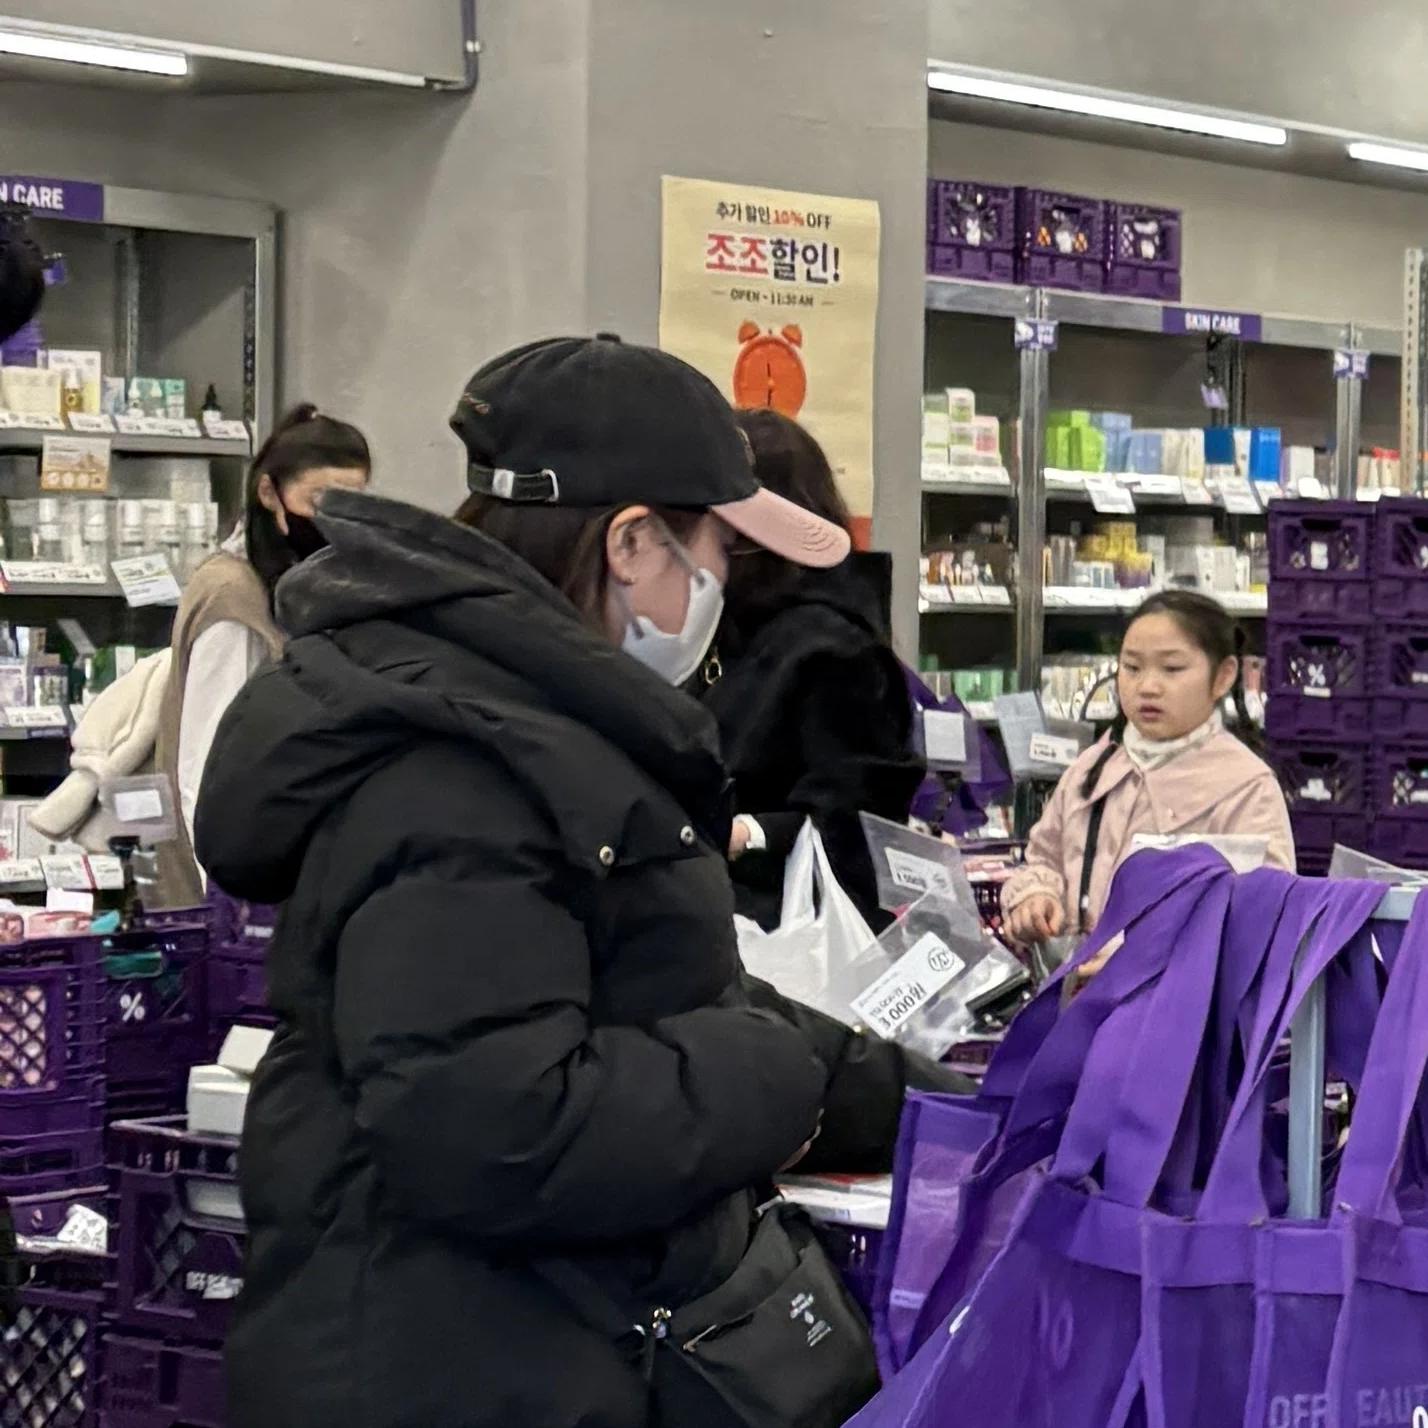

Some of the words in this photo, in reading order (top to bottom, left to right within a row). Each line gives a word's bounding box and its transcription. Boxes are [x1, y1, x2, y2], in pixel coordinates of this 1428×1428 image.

[13, 183, 65, 211] CARE
[774, 209, 804, 227] 10%
[806, 212, 832, 230] OFF
[705, 233, 841, 284] 조조할인!
